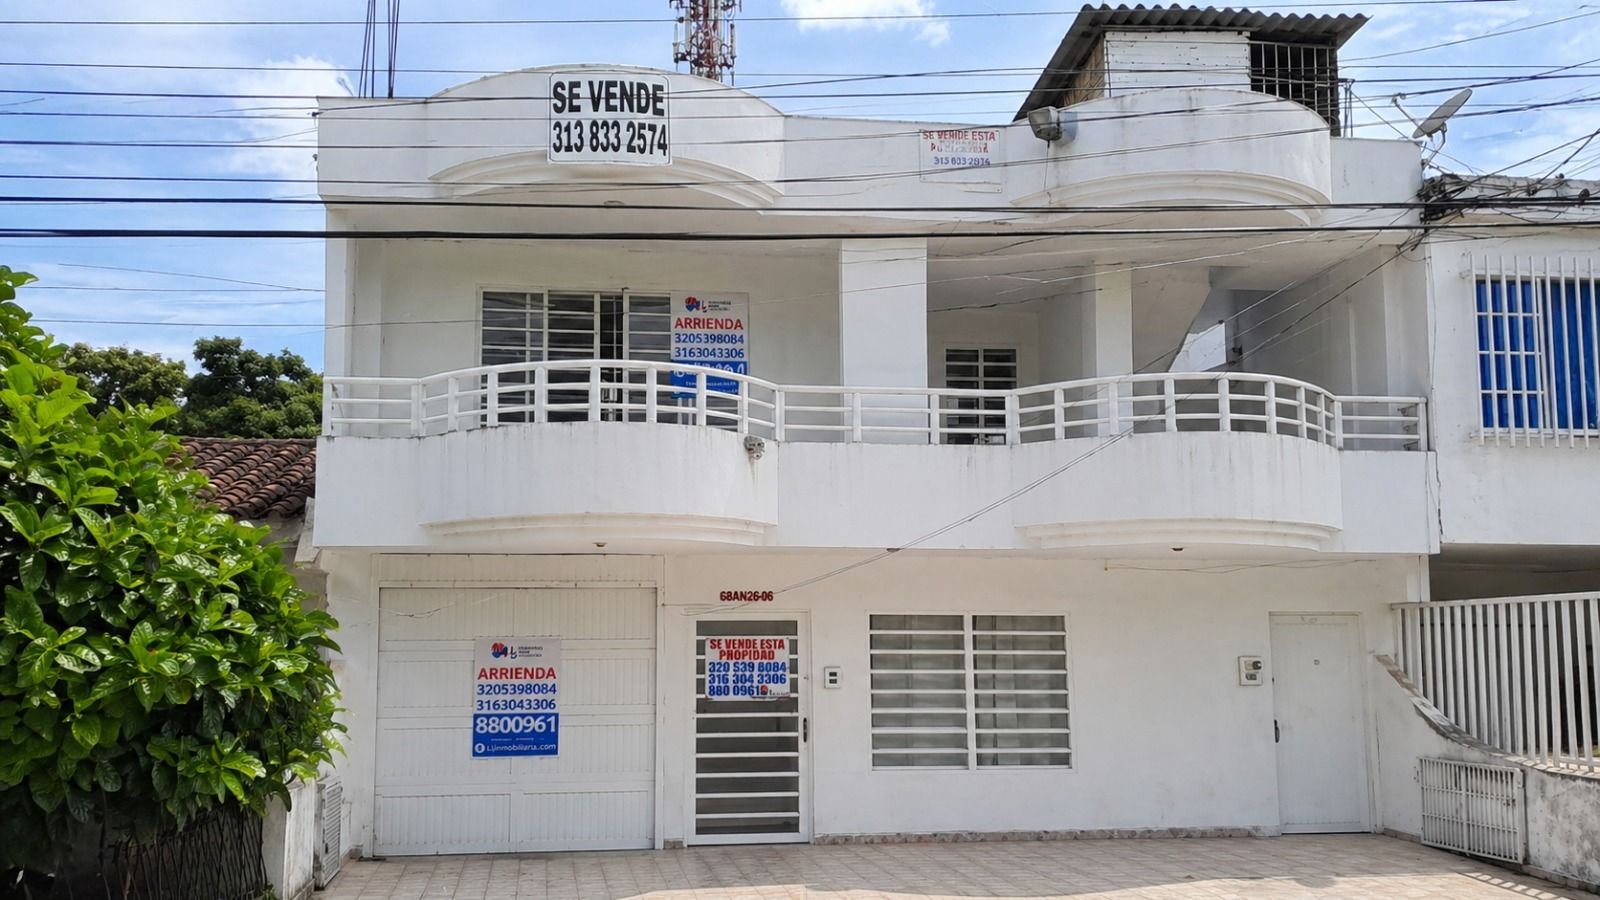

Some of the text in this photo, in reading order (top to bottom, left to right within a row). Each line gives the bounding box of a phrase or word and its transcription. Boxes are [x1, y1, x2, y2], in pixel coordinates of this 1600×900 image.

[552, 80, 665, 117] SE VENDE
[552, 119, 668, 157] 313 833 2574
[971, 131, 996, 142] ESTA
[674, 317, 744, 330] ARRIENDA
[674, 333, 744, 345] 3205398084
[674, 347, 745, 359] 3163043306
[720, 590, 774, 602] 68AN26-06
[710, 639, 785, 650] SE VENDE ESTA
[708, 662, 730, 673] 320
[732, 662, 755, 673] 539
[477, 667, 557, 681] ARRIENDA
[708, 673, 787, 685] 316 304 3306
[476, 683, 557, 696] 3205398084
[708, 685, 730, 697] 880
[476, 699, 556, 711] 3163043306
[475, 715, 556, 734] 8800961
